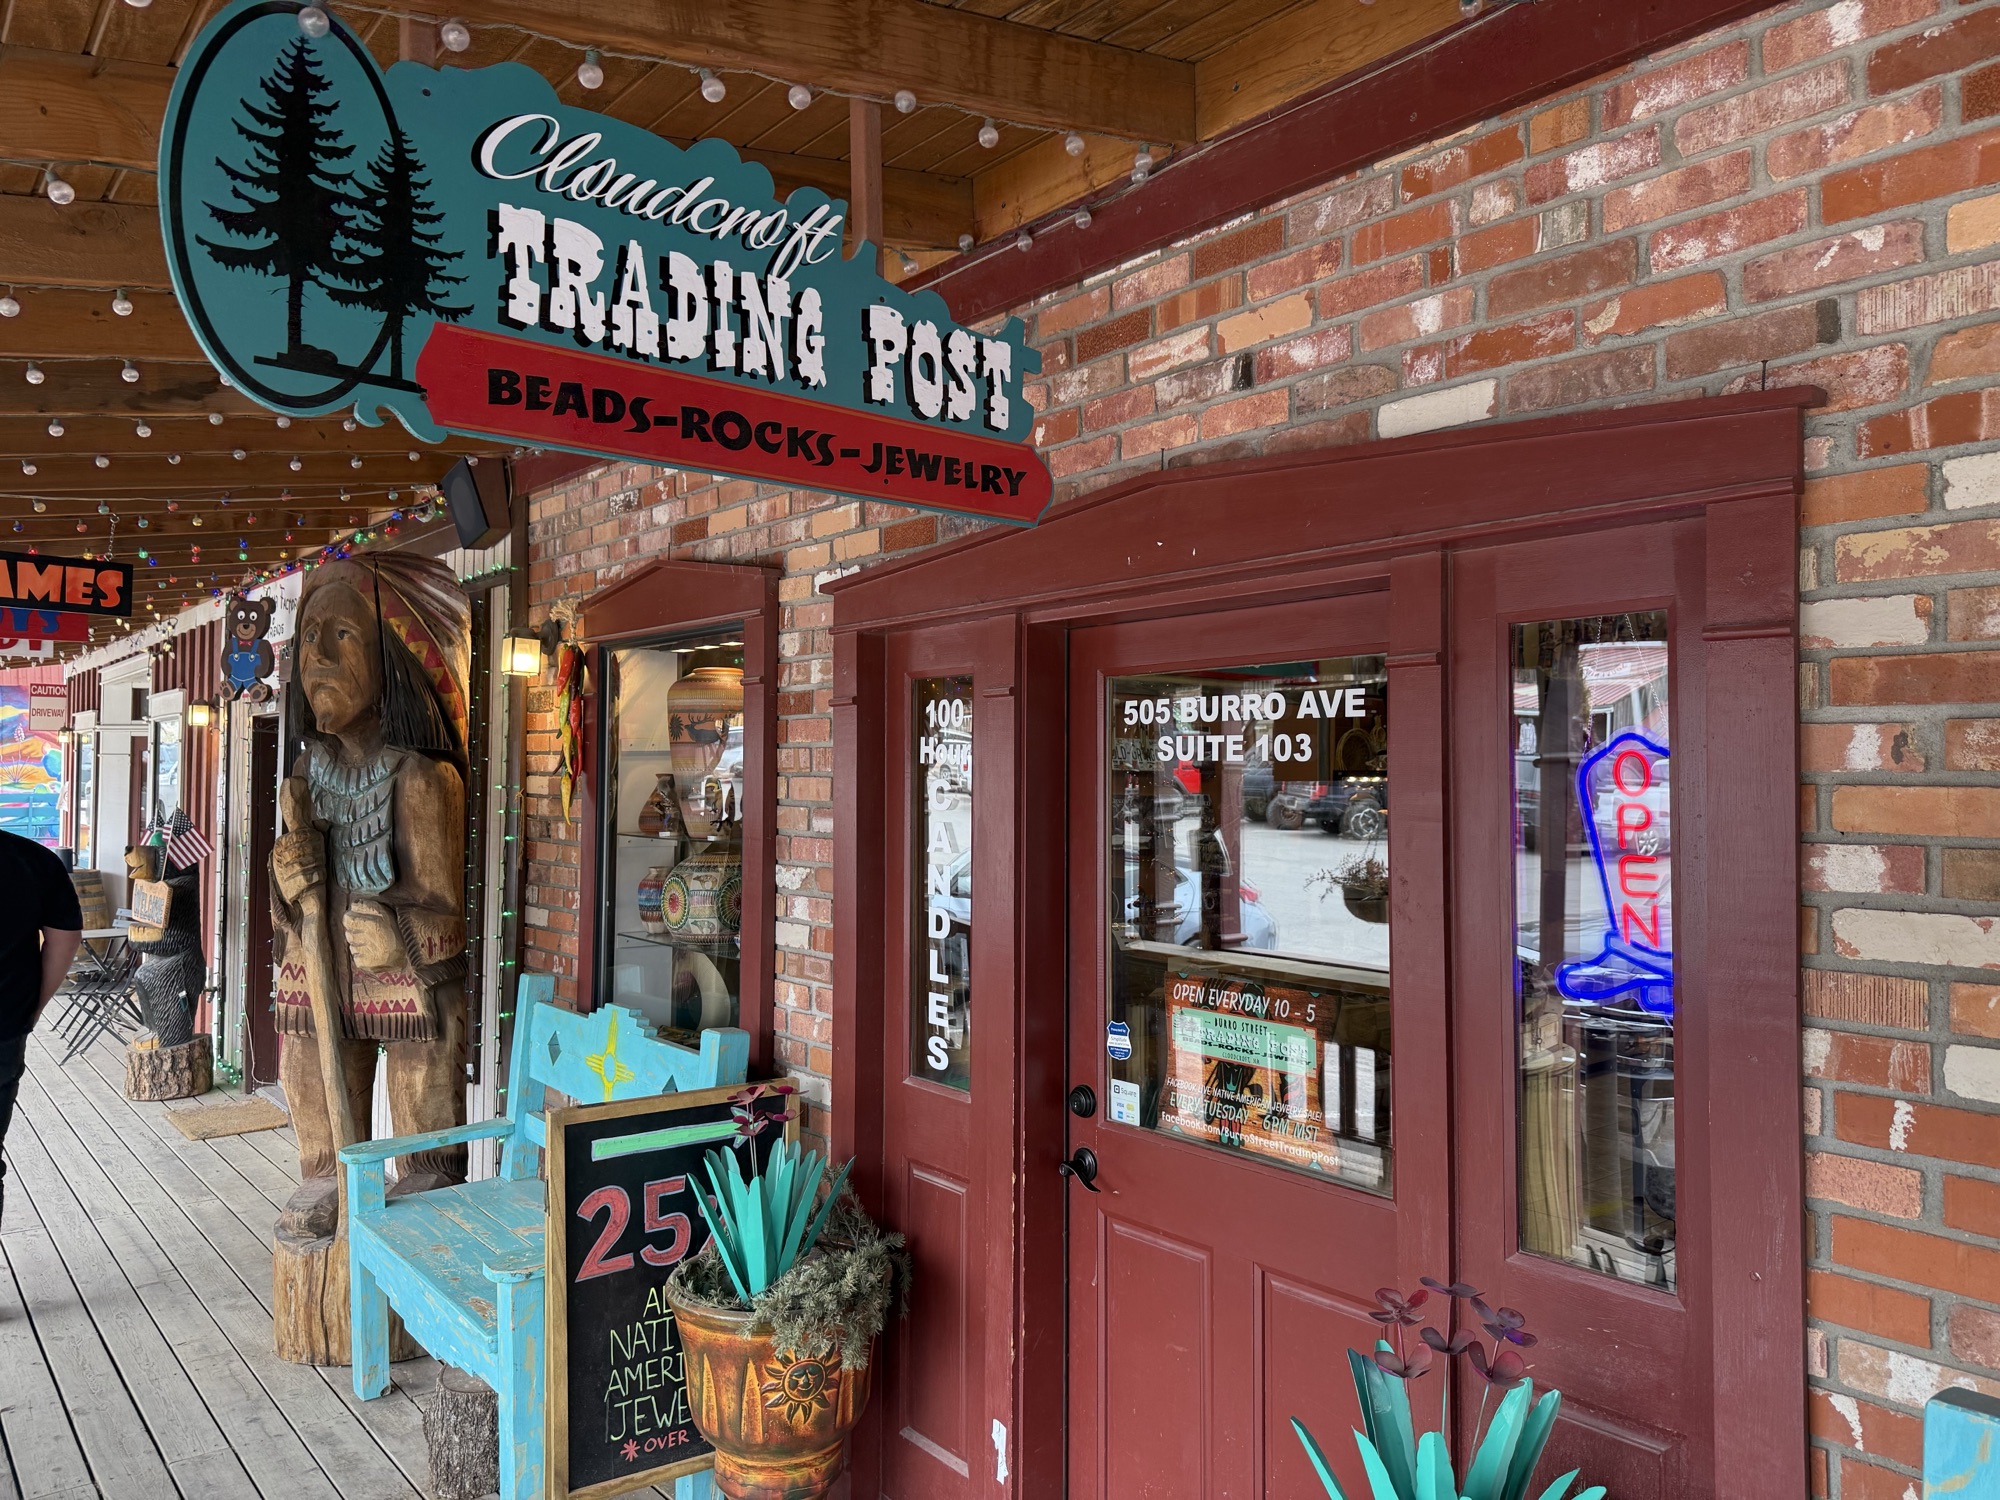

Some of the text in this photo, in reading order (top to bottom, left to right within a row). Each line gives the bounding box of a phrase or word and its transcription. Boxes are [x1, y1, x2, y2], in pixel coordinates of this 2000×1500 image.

[472, 114, 843, 280] Cloudcroft
[487, 203, 1012, 432] TRADING POST
[488, 369, 1027, 496] BEADS-ROCKS-JEWELRY
[31, 685, 67, 696] CAUTION
[1123, 688, 1366, 726] 505 BURRO AVE
[32, 708, 65, 718] DRIVEWAY
[926, 698, 964, 728] 100
[919, 736, 971, 766] Hour
[1157, 733, 1313, 762] SUITE 103
[1613, 750, 1660, 948] OPEN
[926, 779, 951, 1071] CANDLES
[1173, 983, 1205, 1004] OPEN
[1209, 988, 1270, 1014] EVERYDAY
[1274, 999, 1290, 1018] 10
[1306, 1004, 1316, 1022] 5
[1214, 1018, 1268, 1036] BURRO STREET
[1120, 1087, 1137, 1098] Square
[1166, 1077, 1198, 1092] FACEBOOK
[1212, 1087, 1235, 1101] NATIVE
[1236, 1093, 1272, 1111] AMERICAN
[1304, 1108, 1323, 1123] SALE!
[1170, 1092, 1200, 1113] EVERY
[1203, 1099, 1250, 1125] TUESDAY
[1262, 1114, 1289, 1136] 6PM
[1293, 1121, 1320, 1143] MST
